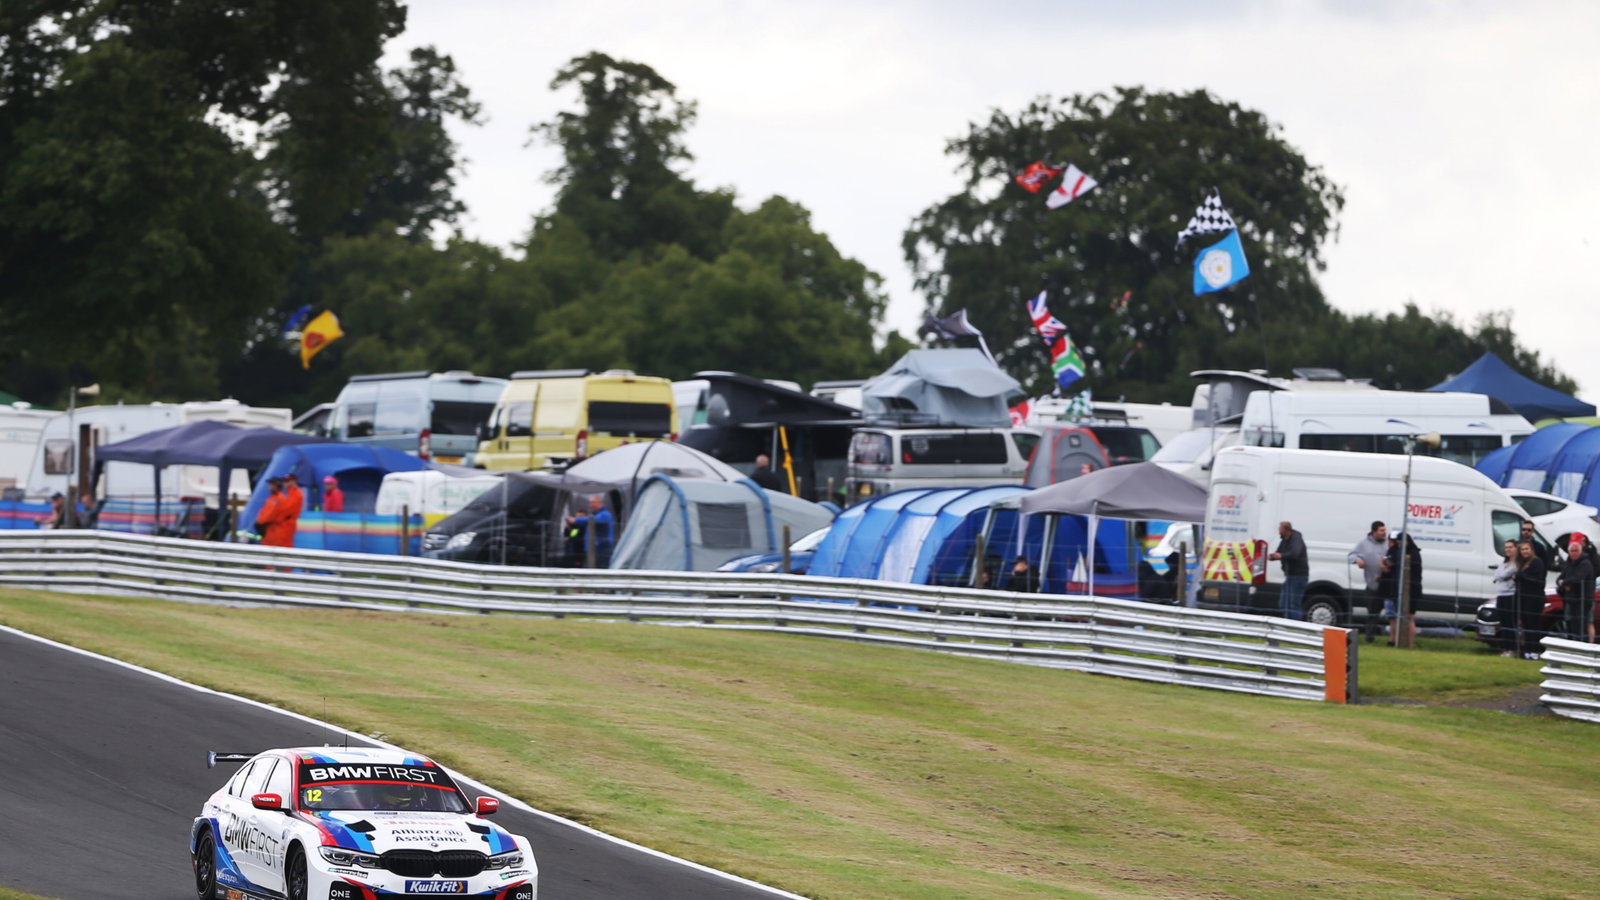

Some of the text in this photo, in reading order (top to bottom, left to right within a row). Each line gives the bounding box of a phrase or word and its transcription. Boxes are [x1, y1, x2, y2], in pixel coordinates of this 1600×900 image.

[1407, 504, 1442, 519] POWER
[307, 789, 322, 802] 12
[395, 835, 467, 843] Assistance
[331, 890, 351, 898] ONE
[516, 892, 532, 900] ONE
